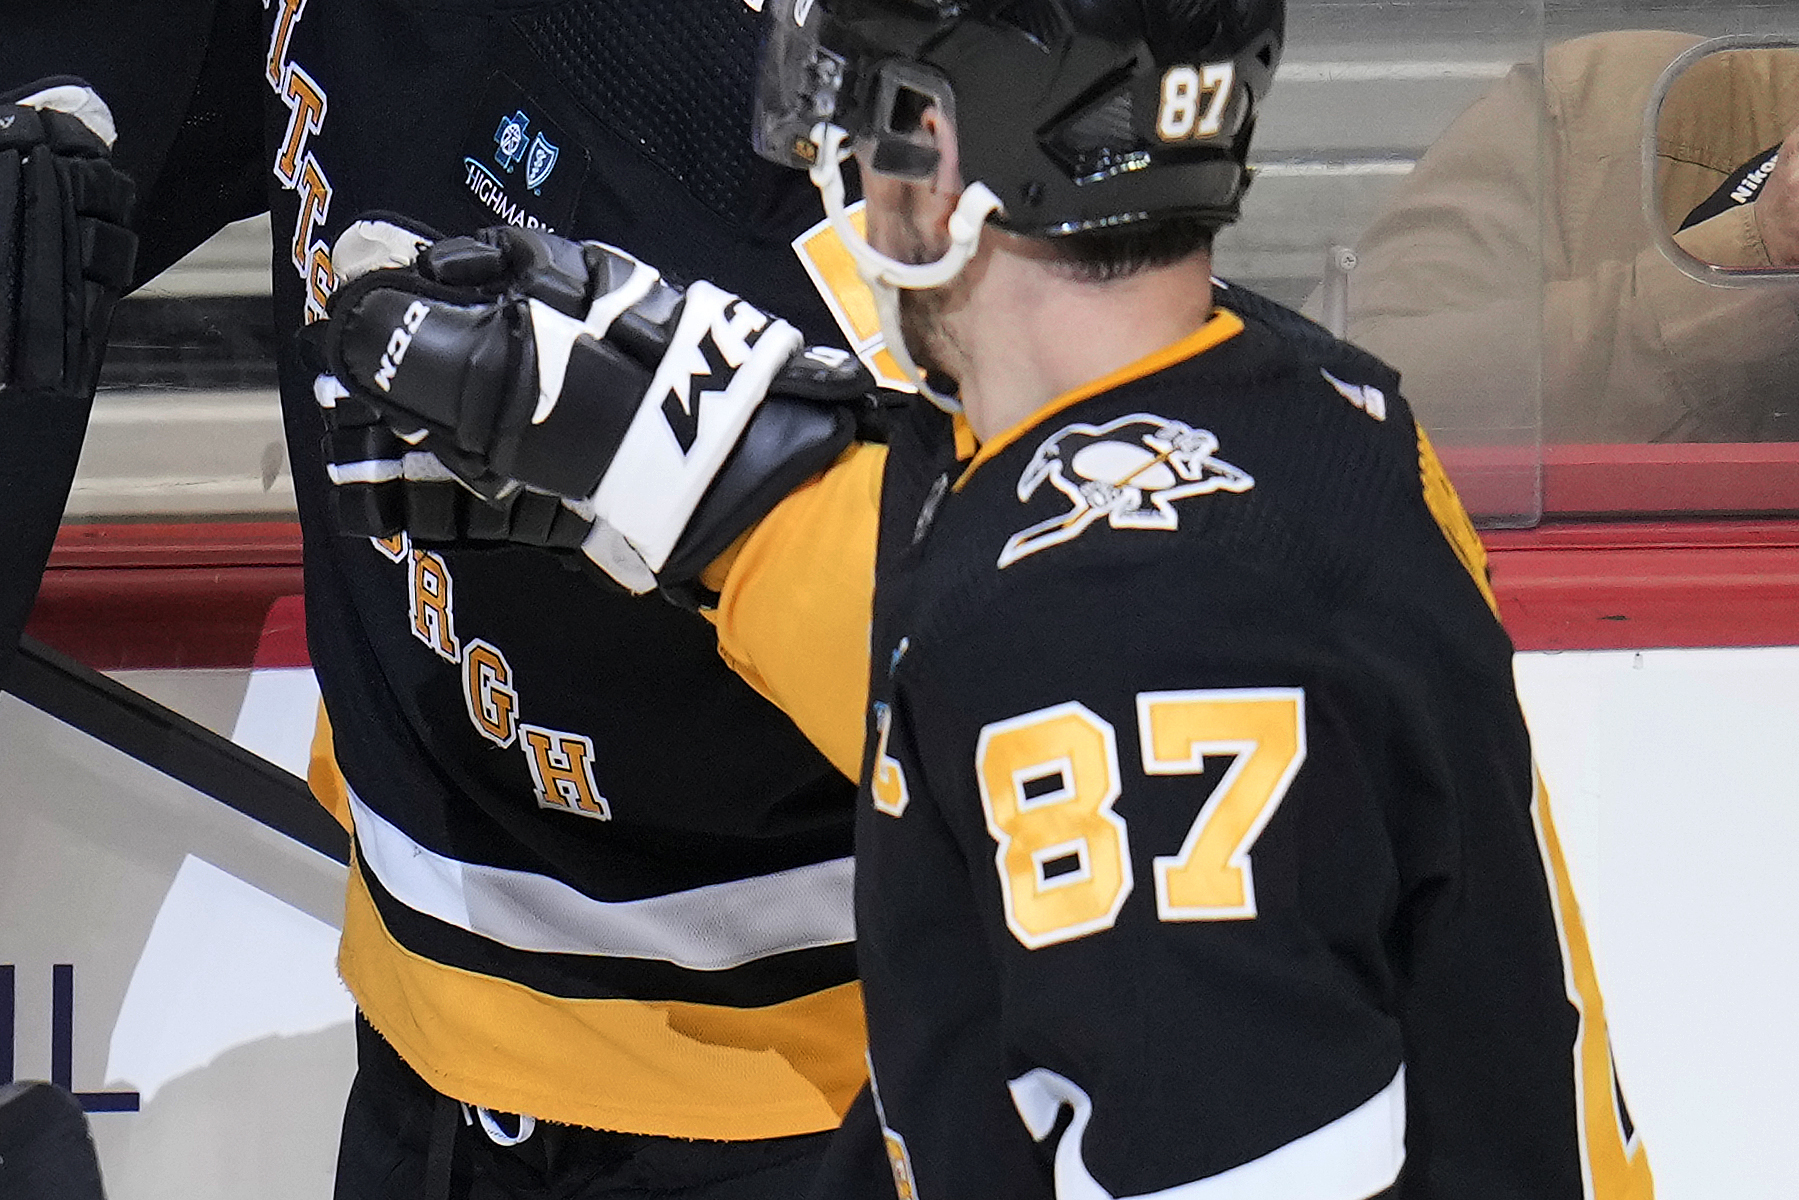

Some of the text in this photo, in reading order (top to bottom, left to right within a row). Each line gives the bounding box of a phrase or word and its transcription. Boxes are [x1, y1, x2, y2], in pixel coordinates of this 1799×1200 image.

[1154, 61, 1234, 144] 87
[374, 298, 431, 392] CCM
[976, 686, 1307, 949] 87
